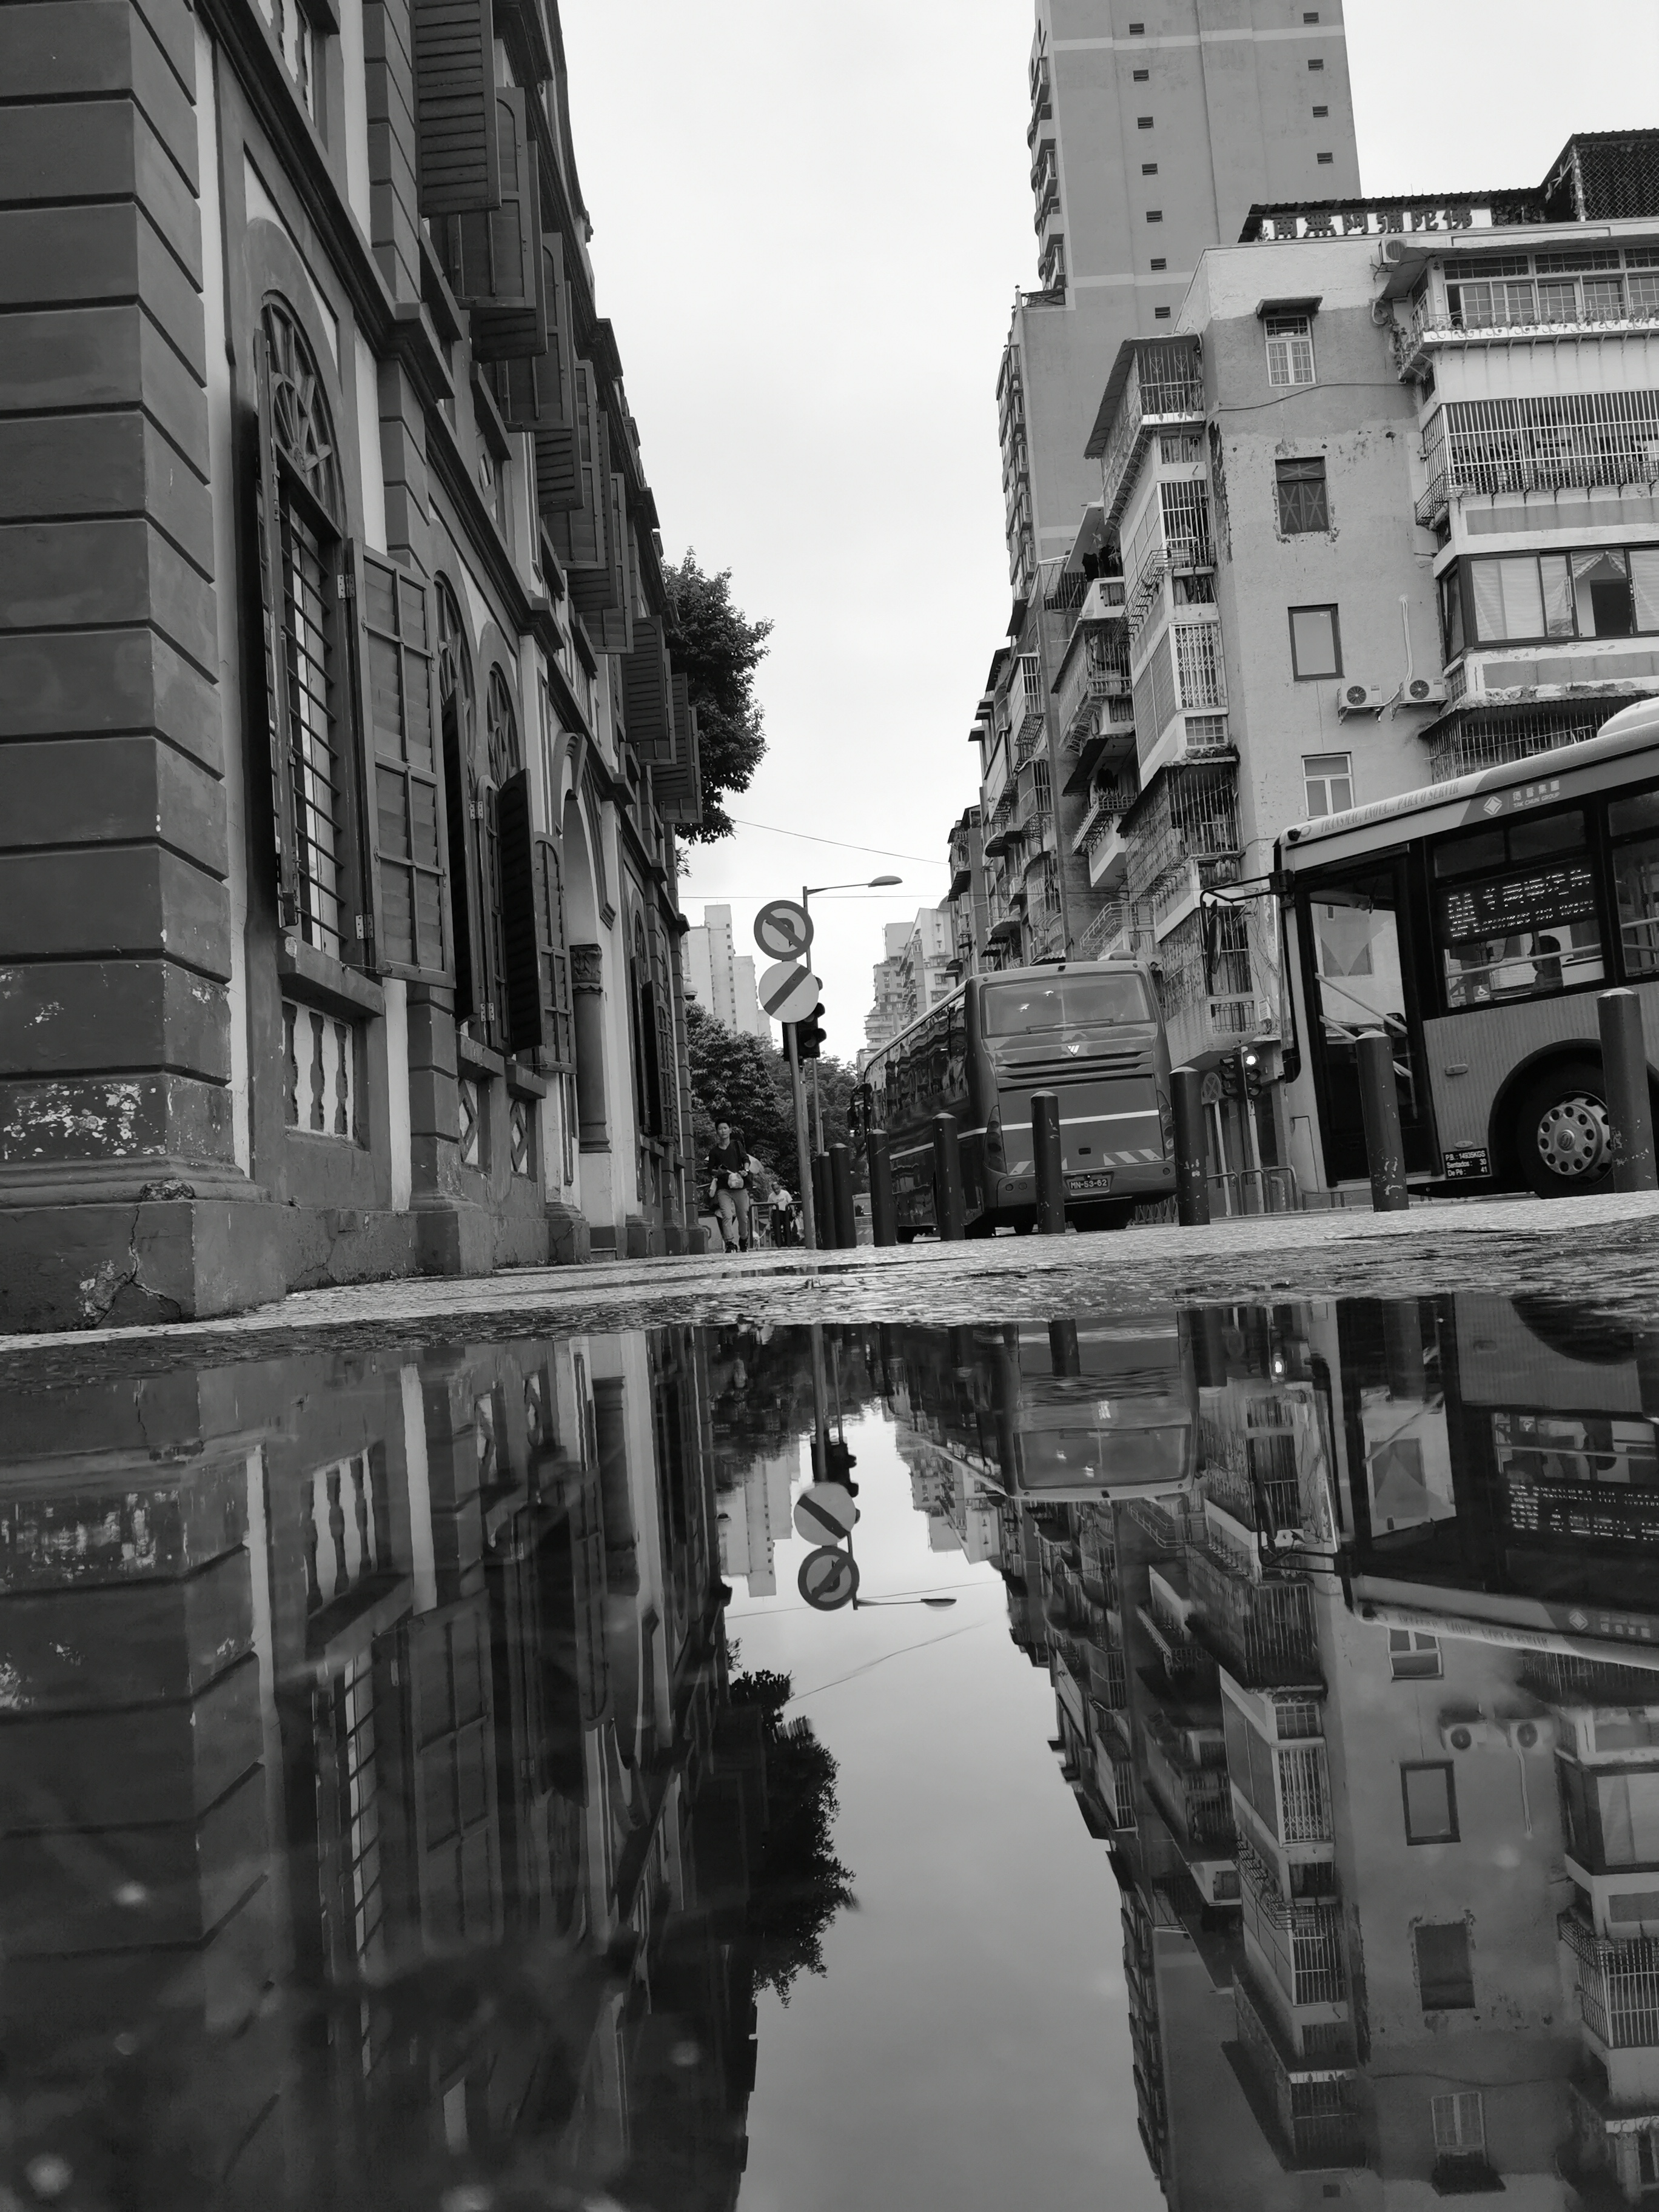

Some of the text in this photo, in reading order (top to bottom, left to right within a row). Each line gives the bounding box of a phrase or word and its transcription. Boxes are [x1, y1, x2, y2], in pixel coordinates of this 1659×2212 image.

[1273, 209, 1472, 240] 南無阿彌陀佛
[1397, 793, 1418, 810] PARA
[1420, 791, 1427, 803] O
[1428, 782, 1458, 801] SERVIR
[1070, 1179, 1107, 1189] MN-53-62
